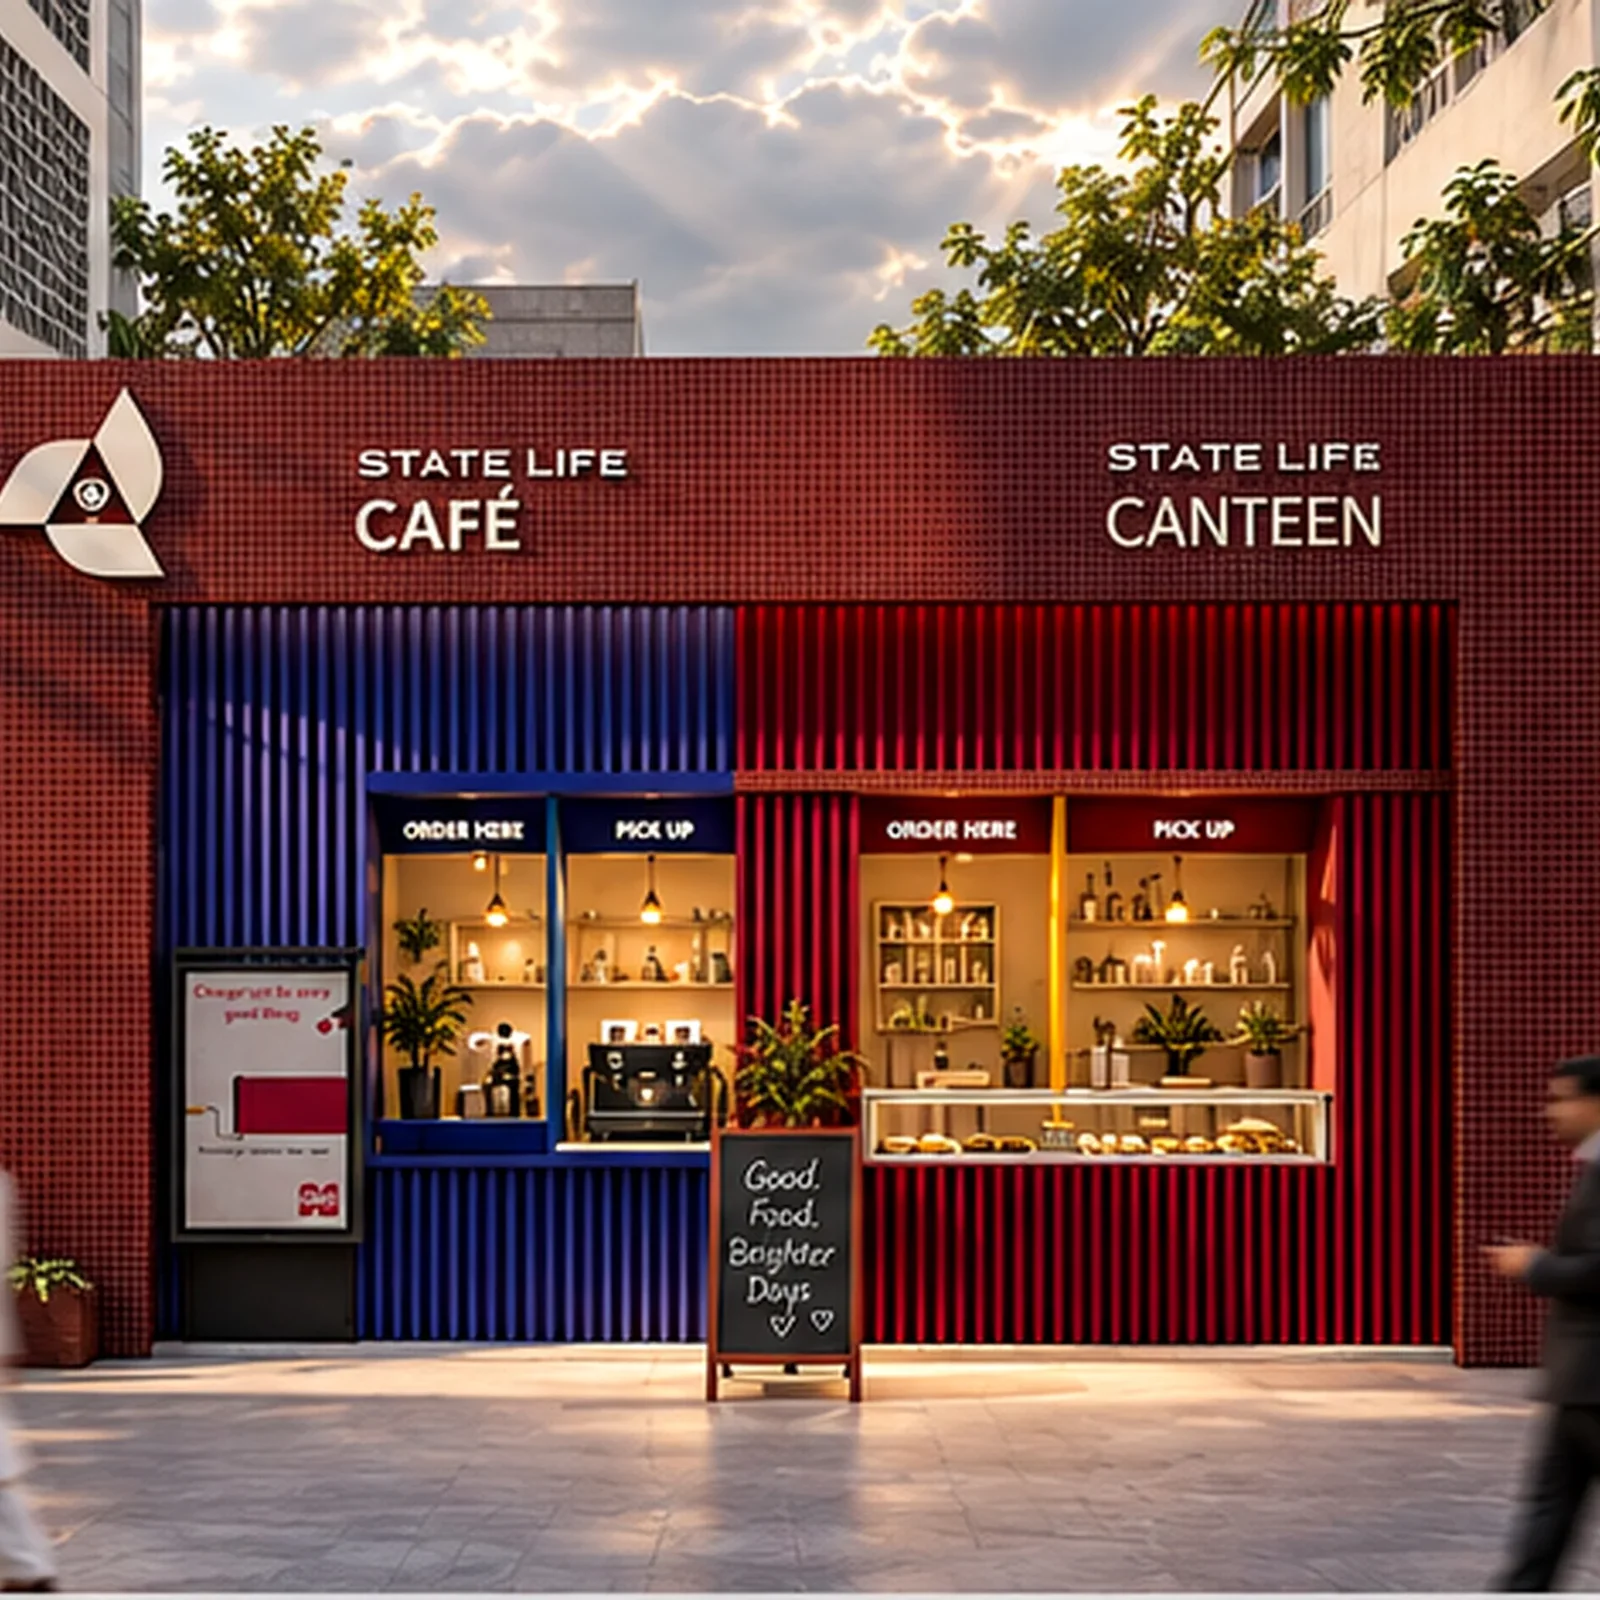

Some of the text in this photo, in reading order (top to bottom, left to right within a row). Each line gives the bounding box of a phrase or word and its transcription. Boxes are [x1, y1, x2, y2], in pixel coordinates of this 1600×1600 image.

[357, 449, 629, 477] STATE LIFE
[1108, 443, 1381, 472] STATE LIFE
[355, 484, 521, 550] CAFÉ
[1106, 496, 1382, 548] CANTEEN
[402, 820, 468, 840] ORDER
[615, 820, 695, 840] PICK UP
[886, 819, 1017, 840] ORDER HERE
[1153, 820, 1236, 839] PICK UP
